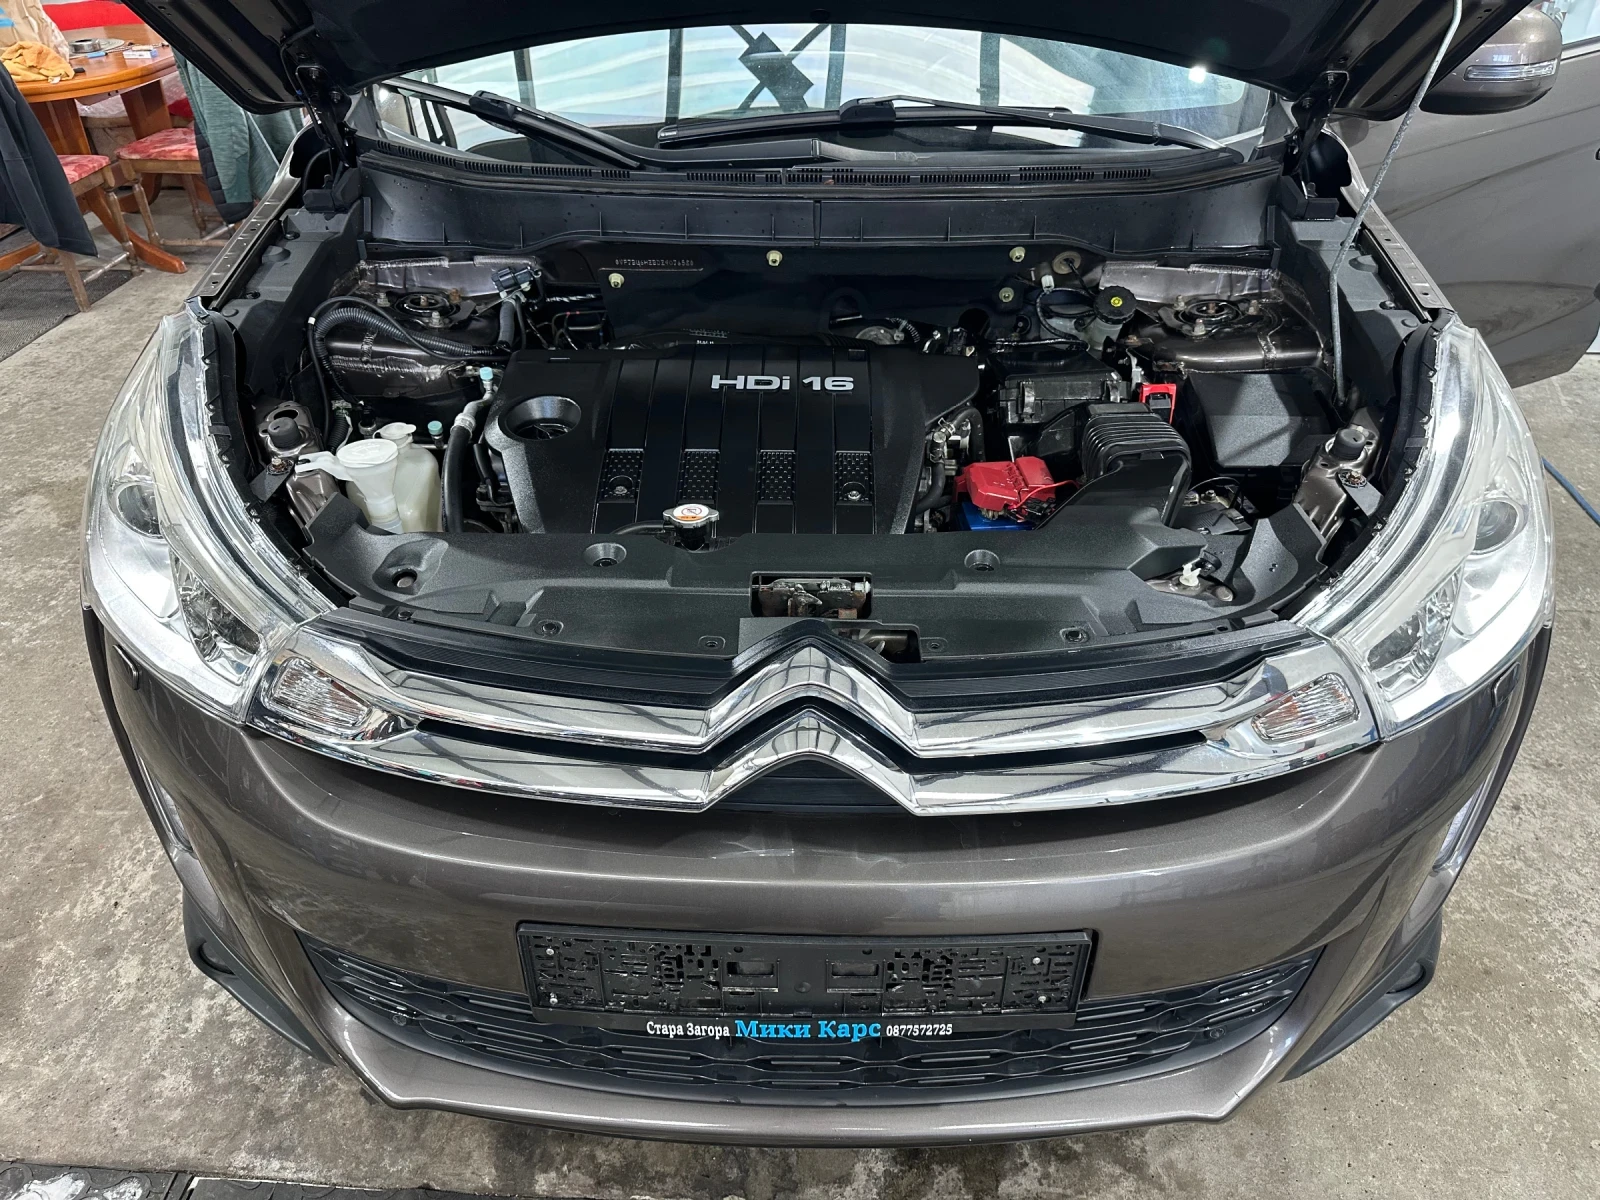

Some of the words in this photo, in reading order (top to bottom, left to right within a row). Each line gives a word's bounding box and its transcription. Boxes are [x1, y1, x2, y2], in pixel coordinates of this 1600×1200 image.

[711, 374, 791, 391] HDi
[802, 376, 855, 391] 16
[646, 1021, 685, 1038] Стара
[686, 1022, 731, 1040] Загора
[735, 1020, 811, 1038] Мики
[817, 1020, 882, 1042] Карс
[886, 1023, 953, 1037] 0877572725
